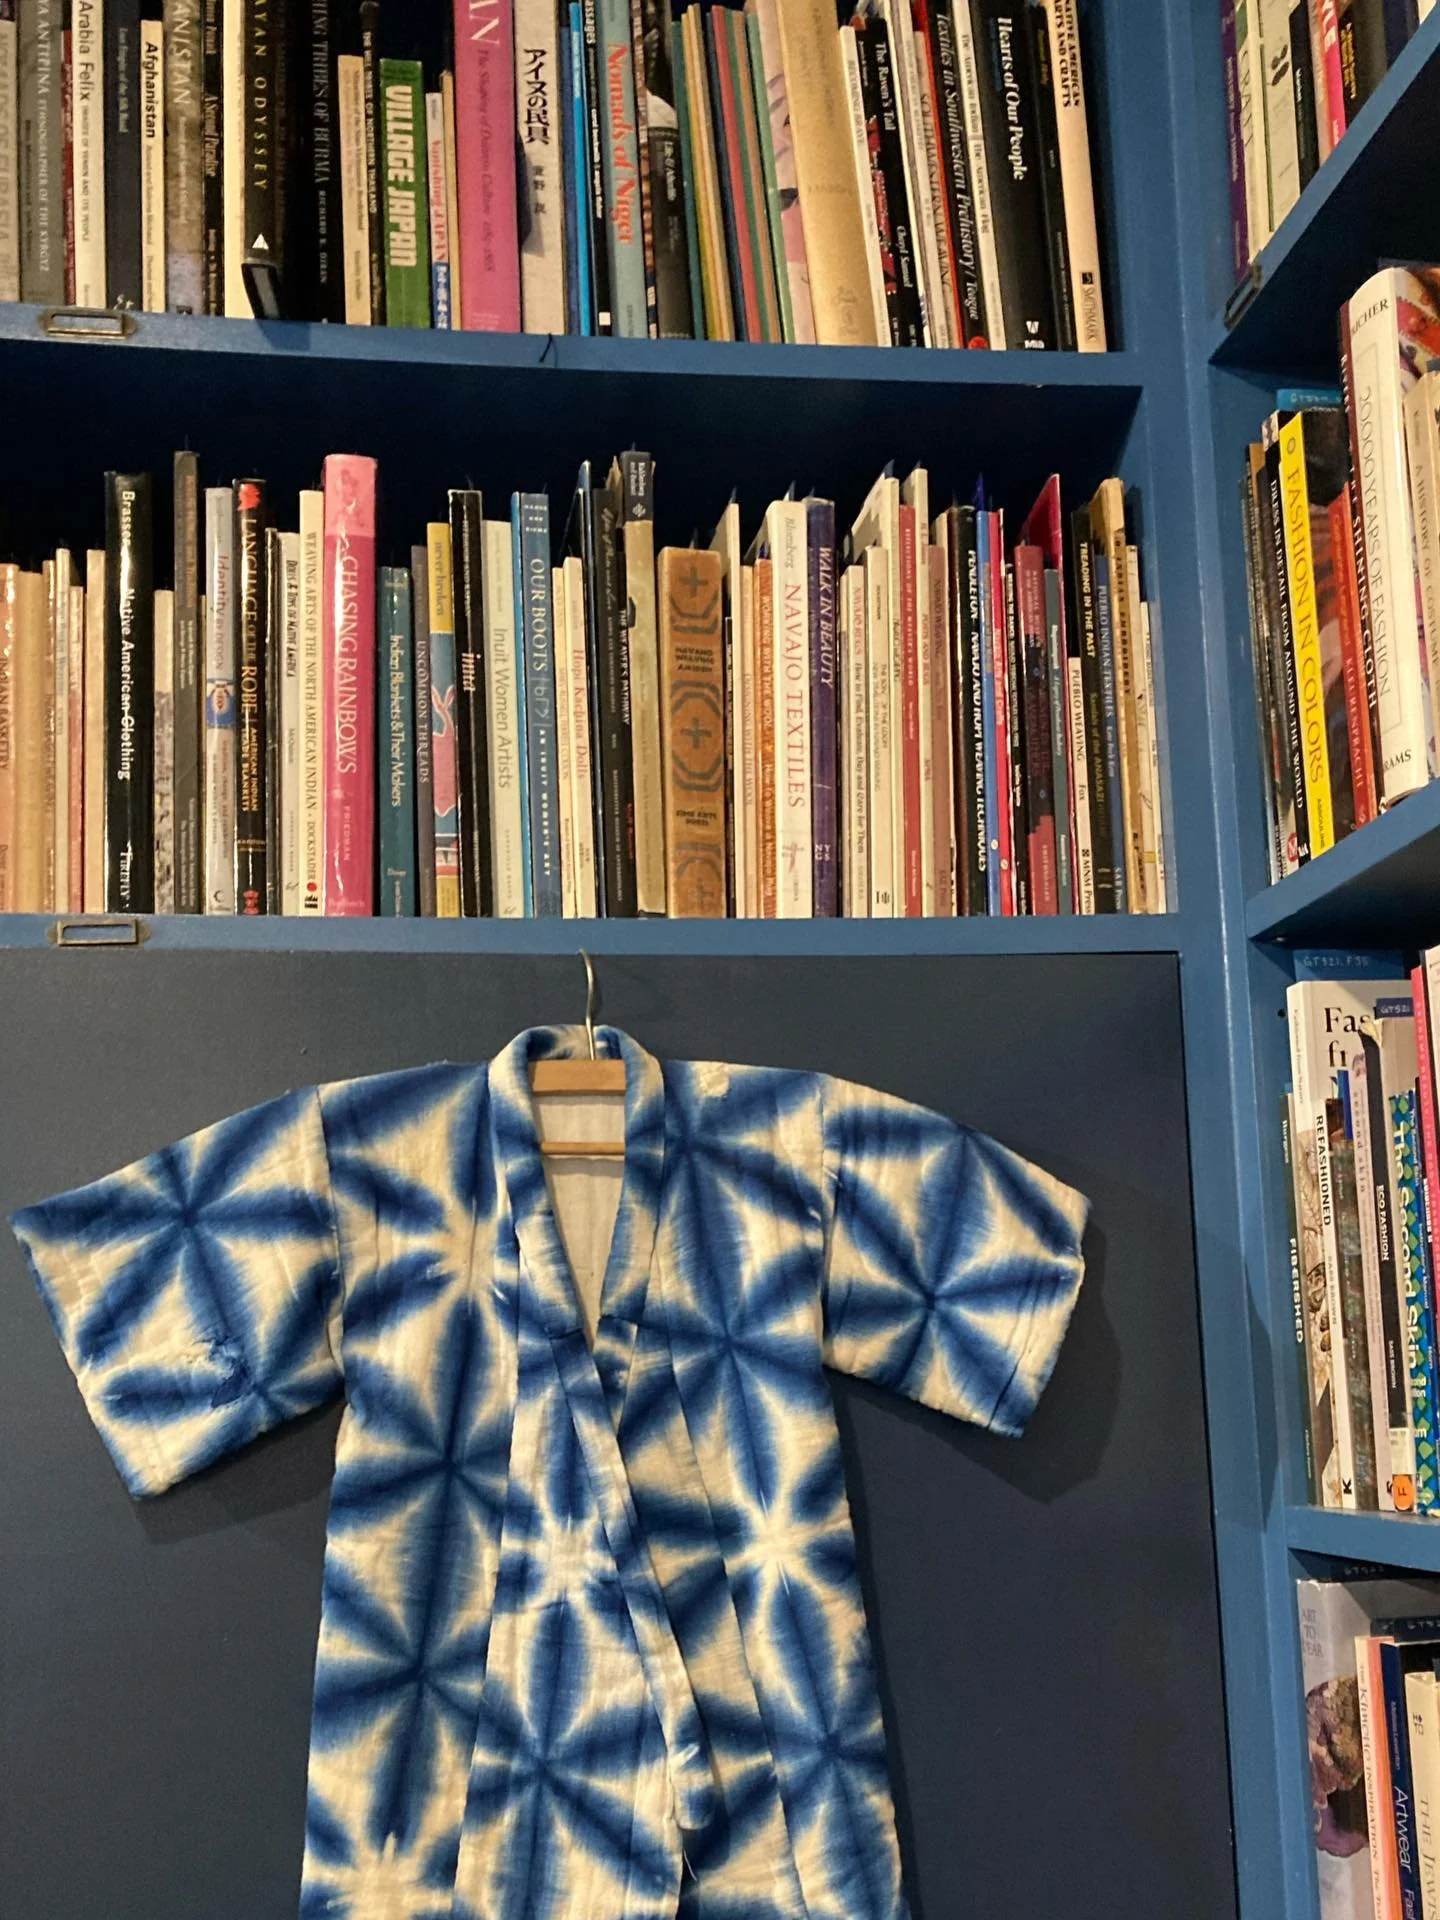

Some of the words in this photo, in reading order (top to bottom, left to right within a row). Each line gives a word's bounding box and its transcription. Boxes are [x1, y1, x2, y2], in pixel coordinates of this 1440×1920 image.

[79, 1, 94, 55] Arabia
[937, 13, 953, 67] Textiles
[998, 17, 1015, 70] Hearts
[477, 49, 490, 69] The
[876, 42, 887, 65] The
[1068, 42, 1081, 108] AMERICAN
[79, 62, 95, 102] Felix
[143, 42, 159, 139] Afghanistan
[476, 71, 490, 113] Shaping
[606, 43, 636, 143] Nomads
[878, 67, 892, 109] Raven's
[943, 69, 955, 87] in
[962, 33, 972, 52] The
[973, 143, 984, 161] The
[1003, 72, 1017, 89] of
[1059, 57, 1072, 108] CRAFTS
[366, 102, 374, 117] OF
[479, 115, 492, 126] of
[882, 112, 896, 131] Tail
[1006, 91, 1022, 123] Our
[254, 77, 268, 191] ODYSSEY
[366, 117, 375, 167] NORTHERN
[385, 85, 414, 183] VILLAGE
[945, 91, 967, 190] Southwestern
[1008, 126, 1028, 182] People
[613, 147, 635, 169] of
[368, 169, 377, 214] THAILAND
[480, 174, 495, 215] Culture
[610, 176, 637, 245] Niger
[387, 186, 417, 267] JAPAN
[433, 210, 445, 261] JAPAN
[896, 226, 909, 255] Cheryl
[955, 192, 976, 269] Prehistory
[964, 281, 981, 323] Teague
[1269, 480, 1281, 527] DRESS
[1366, 480, 1382, 557] YEARS
[304, 531, 317, 584] WEAVING
[435, 541, 445, 574] never
[1274, 529, 1281, 546] IN
[1286, 467, 1313, 606] FASHION
[529, 558, 545, 601] OUR
[819, 546, 834, 593] WALK
[1079, 541, 1092, 594] TREADING
[1275, 548, 1289, 602] DETAIL
[1371, 556, 1384, 592] OF
[121, 588, 135, 636] Native
[305, 586, 317, 616] ARTS
[337, 555, 358, 653] CHASING
[435, 574, 448, 617] broken
[820, 594, 834, 616] IN
[852, 586, 863, 626] NAVAJO
[1082, 594, 1092, 608] IN
[1352, 515, 1370, 621] SHINING
[1362, 628, 1377, 710] CLOTH
[305, 617, 317, 634] OF
[530, 606, 548, 672] BOOTS
[762, 595, 772, 646] WORKING
[783, 583, 803, 683] NAVAJO
[853, 626, 863, 657] RUGS
[1083, 609, 1093, 630] THE
[1279, 604, 1292, 647] FROM
[1298, 611, 1315, 650] IN
[305, 635, 317, 658] THE
[390, 635, 404, 670] Indian
[493, 627, 509, 663] Inuit
[572, 649, 586, 681] Hopi
[763, 646, 772, 674] WITH
[819, 618, 835, 690] BEAUTY
[1085, 632, 1095, 659] PAST
[1372, 595, 1392, 698] FASHION
[121, 640, 136, 710] American
[241, 664, 258, 714] ROBE
[305, 662, 317, 701] NORTH
[390, 670, 404, 720] Blankets
[415, 640, 429, 719] UNCOMMON
[494, 666, 512, 731] Women
[763, 675, 773, 696] THE
[972, 677, 983, 706] AND
[1071, 668, 1082, 711] PUEBLO
[1284, 651, 1297, 716] AROUND
[304, 703, 317, 764] AMERICAN
[337, 656, 357, 774] RAINBOWS
[540, 728, 547, 745] AN
[573, 684, 588, 744] Kachina
[763, 698, 773, 731] WOOL
[1073, 711, 1086, 763] WEAVING
[1289, 720, 1299, 749] THE
[1301, 656, 1324, 785] COLORS
[117, 715, 136, 781] Clothing
[391, 730, 405, 761] Their
[416, 723, 429, 785] THREADS
[497, 734, 513, 791] Artists
[540, 751, 549, 787] INUIT
[576, 745, 590, 780] Dolls
[786, 690, 806, 809] TEXTILES
[974, 741, 986, 796] WEAVING
[305, 765, 318, 811] INDIAN
[391, 761, 406, 808] Makers
[764, 762, 773, 785] How
[765, 785, 773, 798] to
[857, 774, 866, 792] and
[1077, 784, 1087, 802] Fox
[1290, 752, 1304, 810] WORLD
[343, 805, 351, 861] FRIEDMAN
[541, 792, 550, 848] WOMEN'S
[765, 798, 774, 834] Weave
[976, 796, 988, 872] TECHNIQUES
[306, 821, 317, 881] DOCKSTADER
[858, 829, 868, 855] Them
[765, 876, 777, 898] Rug
[1082, 859, 1092, 888] MNM
[1083, 888, 1094, 915] Press
[1315, 1115, 1333, 1227] REFASHIONED
[1393, 1121, 1405, 1181] The
[1376, 1184, 1386, 1210] ECO
[1377, 1210, 1390, 1263] FASHION
[1396, 1186, 1417, 1298] Second
[1288, 1237, 1304, 1344] FIBERSHED
[1405, 1304, 1420, 1370] Skin
[1394, 1785, 1412, 1876] Artwear
